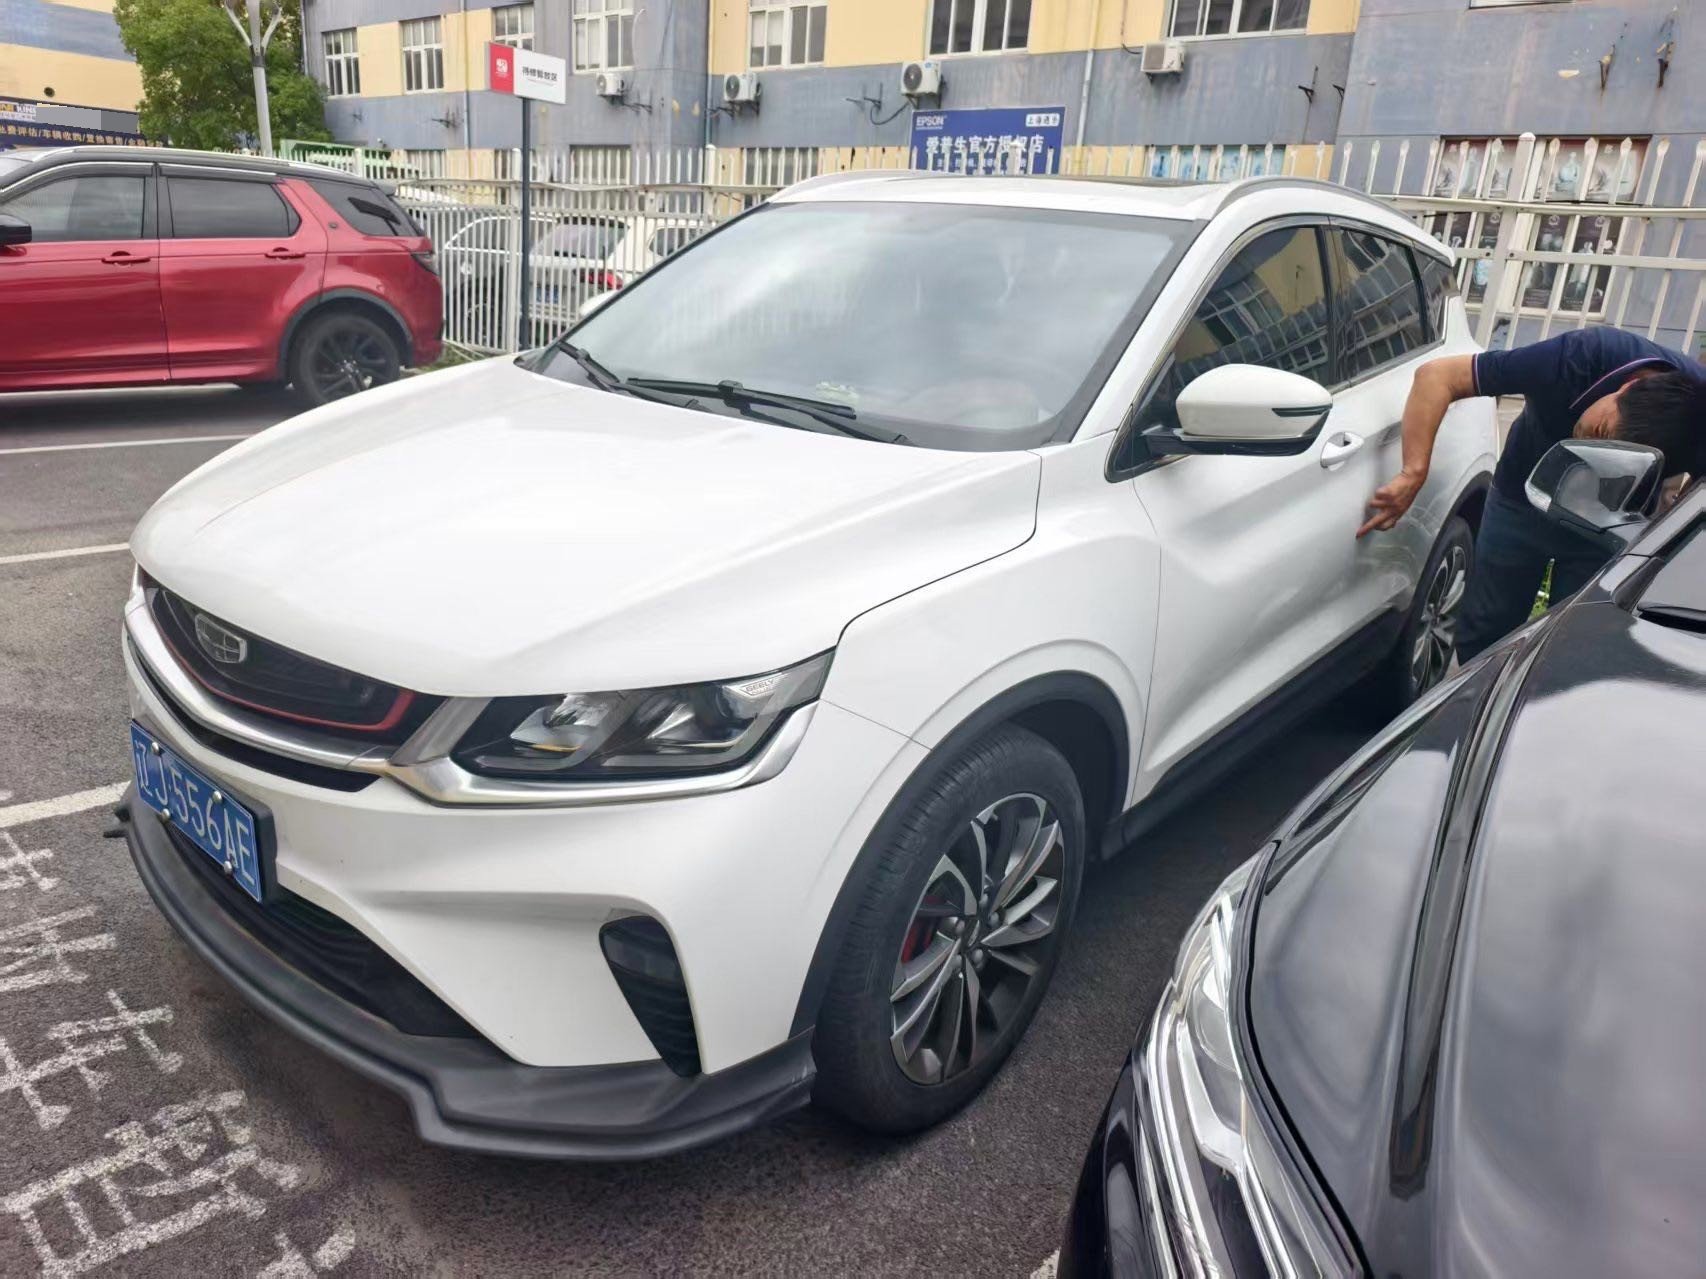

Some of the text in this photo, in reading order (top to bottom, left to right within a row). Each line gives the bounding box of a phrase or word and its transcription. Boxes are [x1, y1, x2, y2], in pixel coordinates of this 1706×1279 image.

[916, 115, 944, 127] EPSON
[926, 135, 1045, 154] 爱普生官方授权店
[745, 679, 775, 693] GEELY
